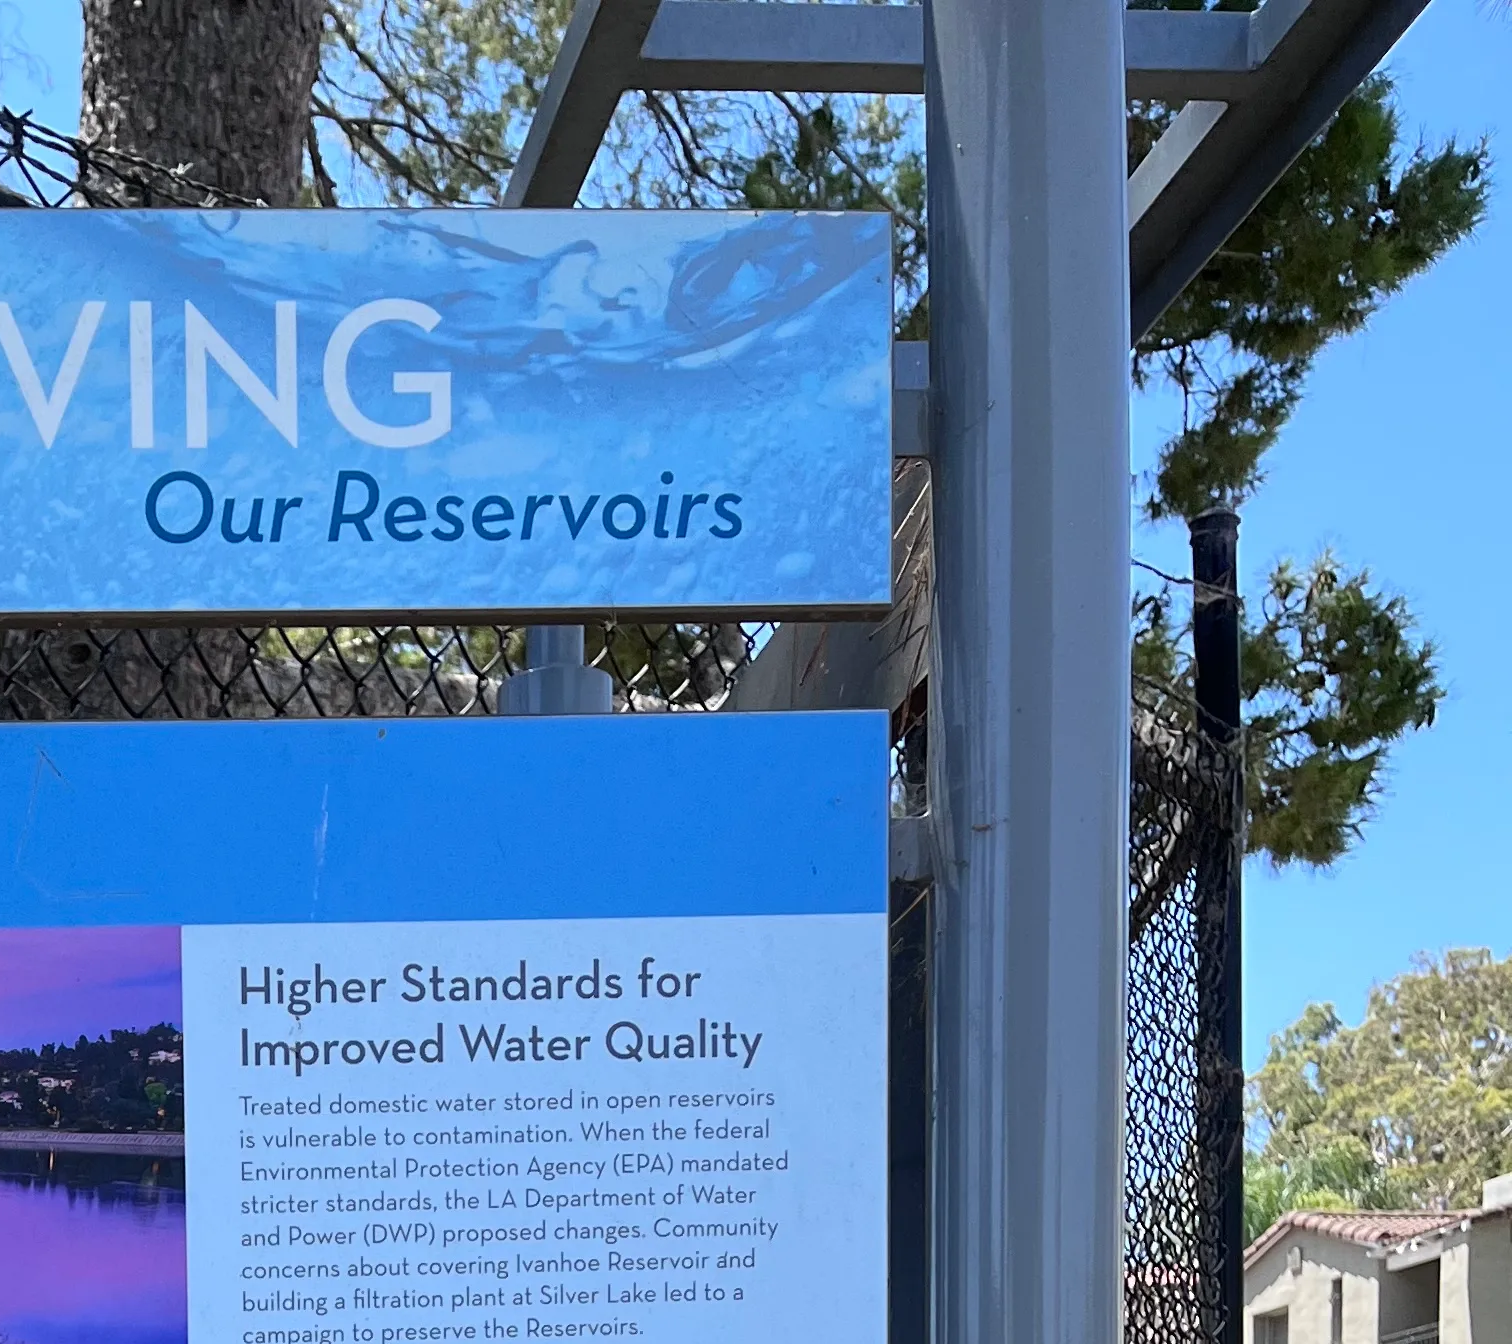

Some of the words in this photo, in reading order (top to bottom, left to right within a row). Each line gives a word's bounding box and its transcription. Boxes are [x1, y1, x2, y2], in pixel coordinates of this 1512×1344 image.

[145, 470, 304, 545] Our
[327, 470, 743, 543] Reservoirs
[240, 963, 387, 1021] Higher
[401, 958, 623, 1003] Standards
[637, 956, 702, 999] for
[241, 1022, 444, 1077] Improved
[458, 1023, 592, 1063] Water
[605, 1017, 763, 1070] Quality
[238, 1093, 322, 1116] Treated
[329, 1093, 429, 1115] domestic
[435, 1093, 497, 1113] water
[503, 1088, 574, 1111] stored
[581, 1090, 599, 1110] in
[606, 1095, 661, 1115] open
[669, 1087, 776, 1108] reservoirs
